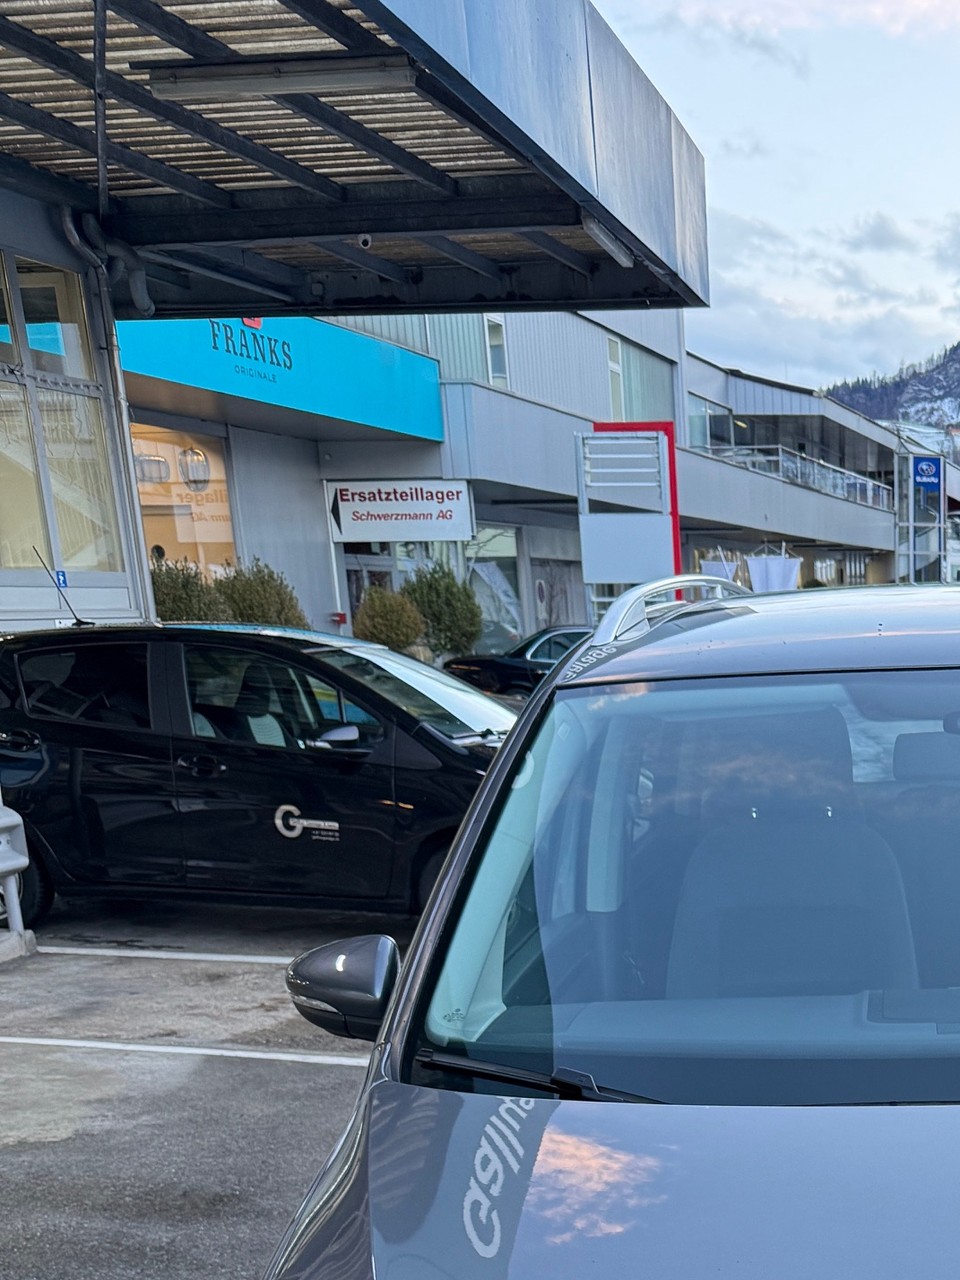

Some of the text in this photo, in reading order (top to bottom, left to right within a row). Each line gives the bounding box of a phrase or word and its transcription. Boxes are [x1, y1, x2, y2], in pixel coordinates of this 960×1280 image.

[208, 318, 293, 371] FRANKS
[234, 365, 277, 383] ORIGINALE
[339, 487, 463, 504] Ersatzteillager
[351, 509, 453, 522] Schwerzmann AG
